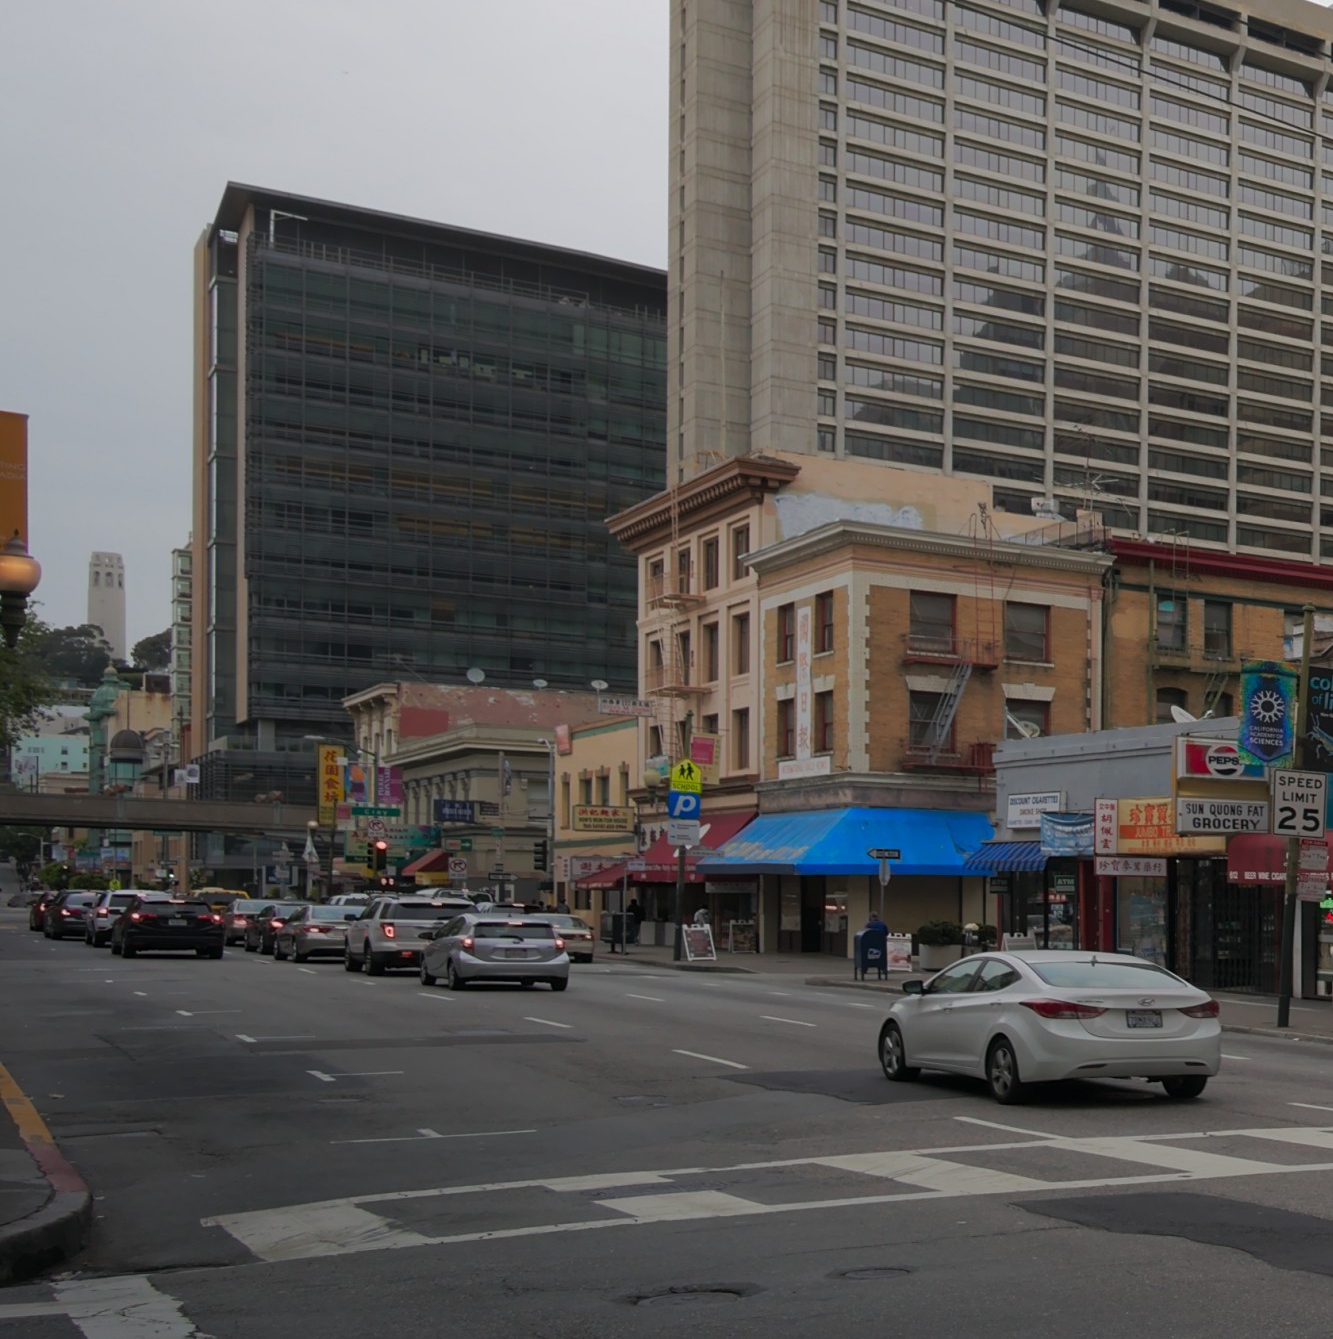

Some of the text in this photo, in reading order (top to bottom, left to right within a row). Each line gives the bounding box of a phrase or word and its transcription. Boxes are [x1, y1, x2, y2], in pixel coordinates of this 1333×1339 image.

[1311, 693, 1324, 705] of
[1250, 725, 1284, 733] CALIFORNIA
[1249, 737, 1284, 747] SCIENCES
[1208, 755, 1241, 766] PEPS
[672, 782, 698, 791] SCHOOL
[1278, 776, 1322, 789] SPEED
[1282, 791, 1317, 804] LIMIT
[1186, 803, 1265, 817] SUN QUONG FAT
[1192, 818, 1260, 830] GROCERY
[1278, 806, 1320, 832] 25
[1244, 871, 1257, 880] BEER
[1258, 871, 1270, 880] WINE
